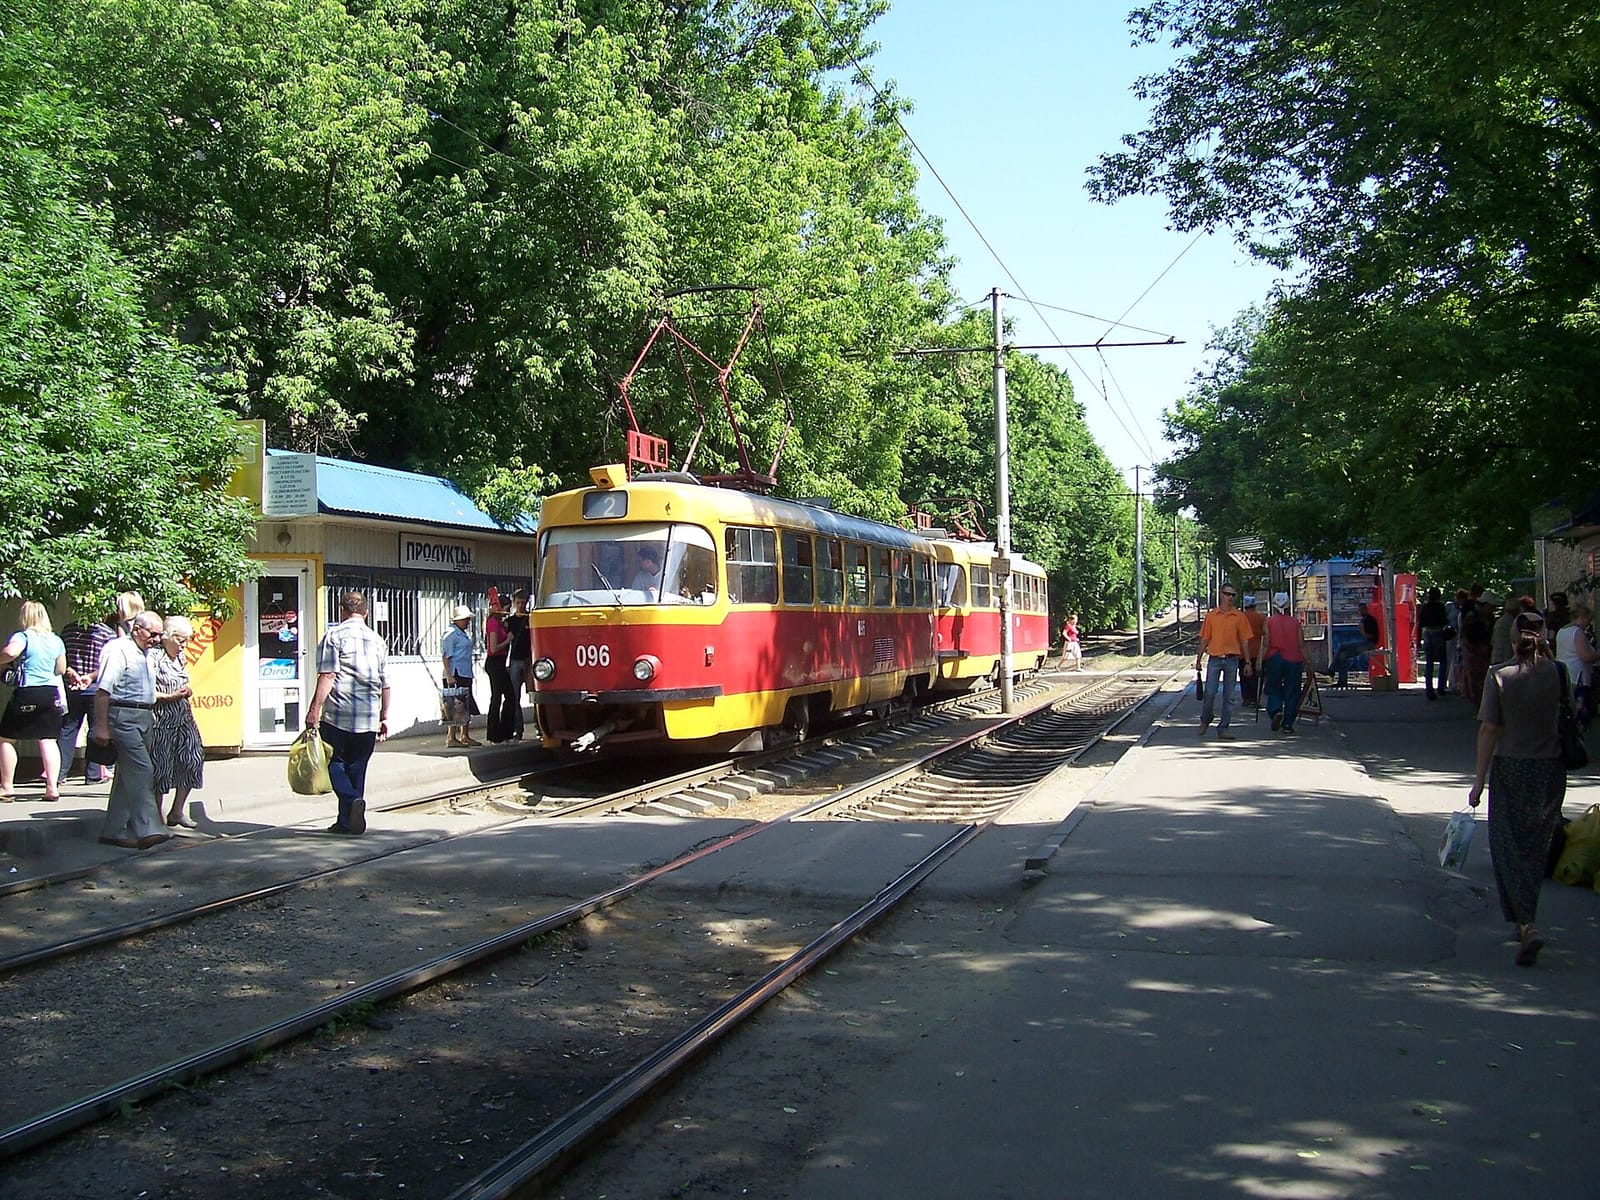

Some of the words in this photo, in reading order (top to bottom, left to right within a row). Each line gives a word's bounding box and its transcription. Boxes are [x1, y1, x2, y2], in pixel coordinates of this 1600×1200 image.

[603, 496, 616, 515] 2
[406, 541, 472, 564] ПРОДУКТЫ
[576, 644, 611, 667] 096
[262, 665, 293, 676] Dirol
[190, 694, 234, 710] АКОВО
